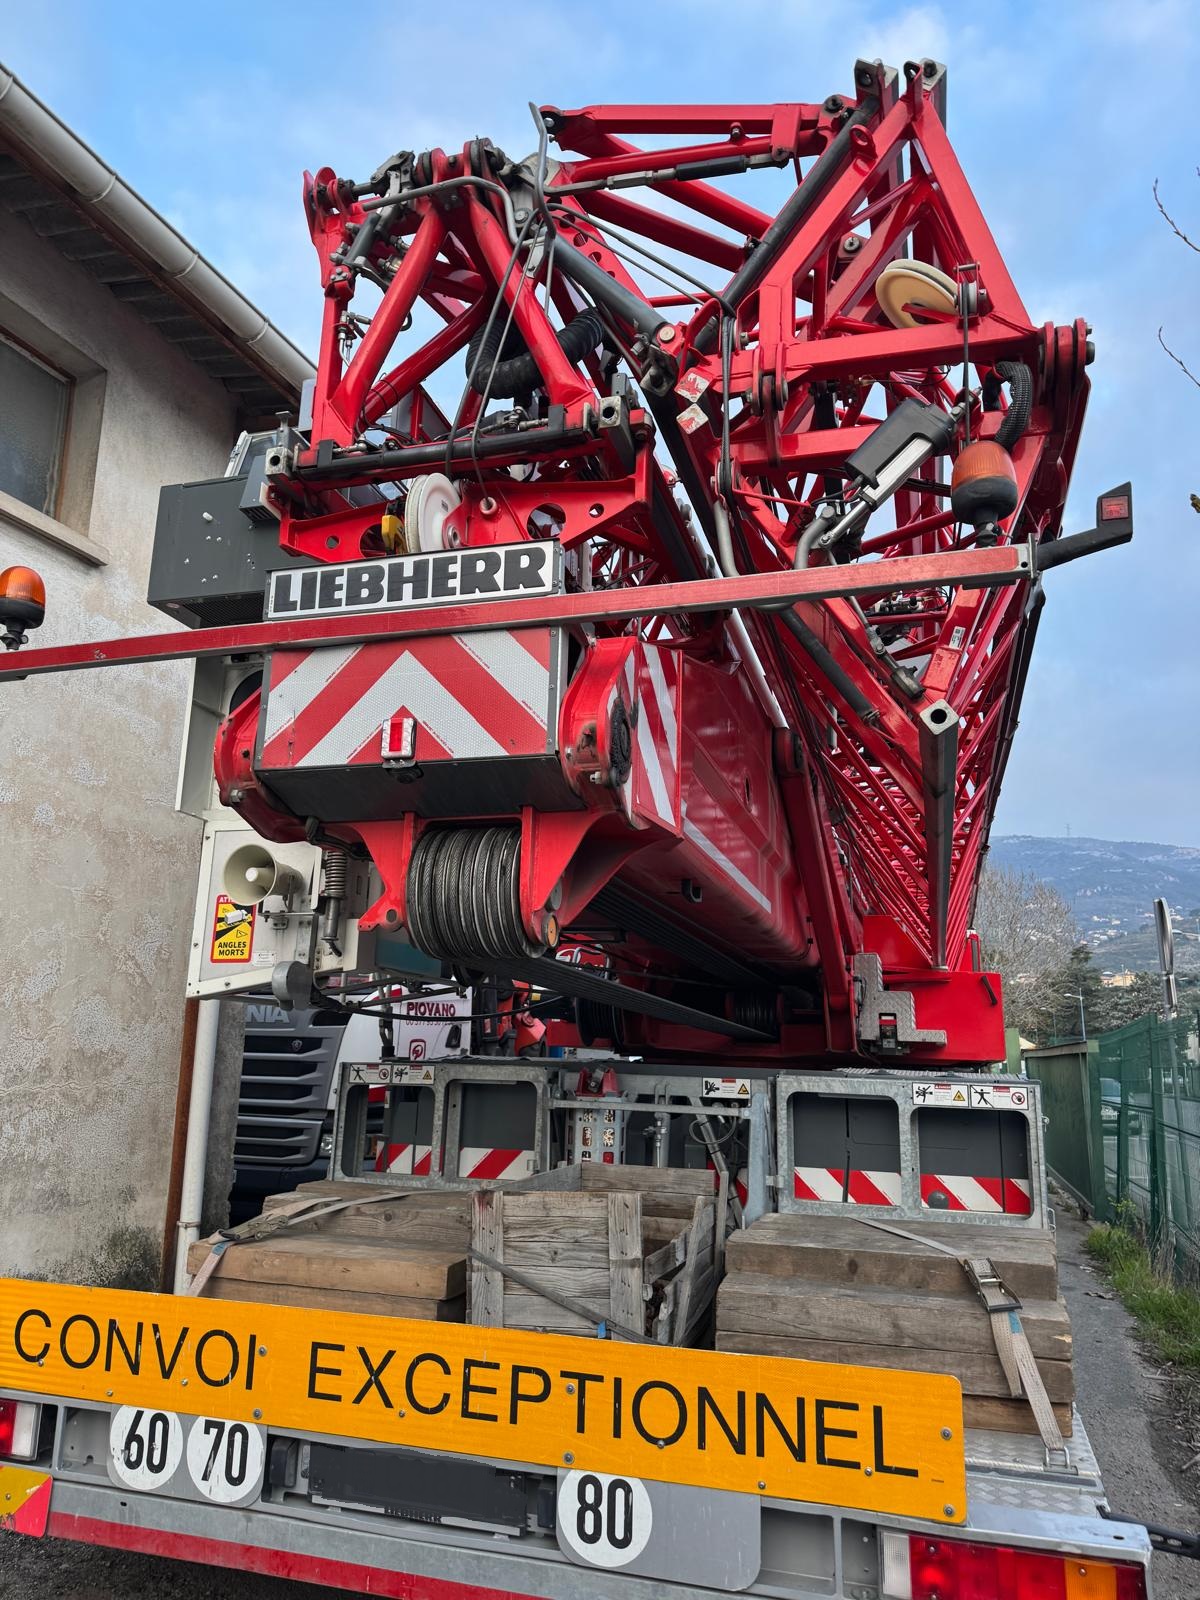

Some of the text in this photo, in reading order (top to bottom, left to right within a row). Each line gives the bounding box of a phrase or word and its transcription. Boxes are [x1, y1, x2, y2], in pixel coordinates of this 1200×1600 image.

[274, 547, 546, 612] LIEBHERR
[218, 941, 247, 949] ANGLES
[218, 948, 245, 957] MORTS
[246, 1004, 290, 1023] NIA
[406, 1002, 456, 1017] PIOVANO
[14, 1308, 919, 1478] CONVOI EXCEPTIONNEL
[122, 1409, 170, 1474] 60
[203, 1419, 250, 1487] 70
[576, 1473, 634, 1550] 80
